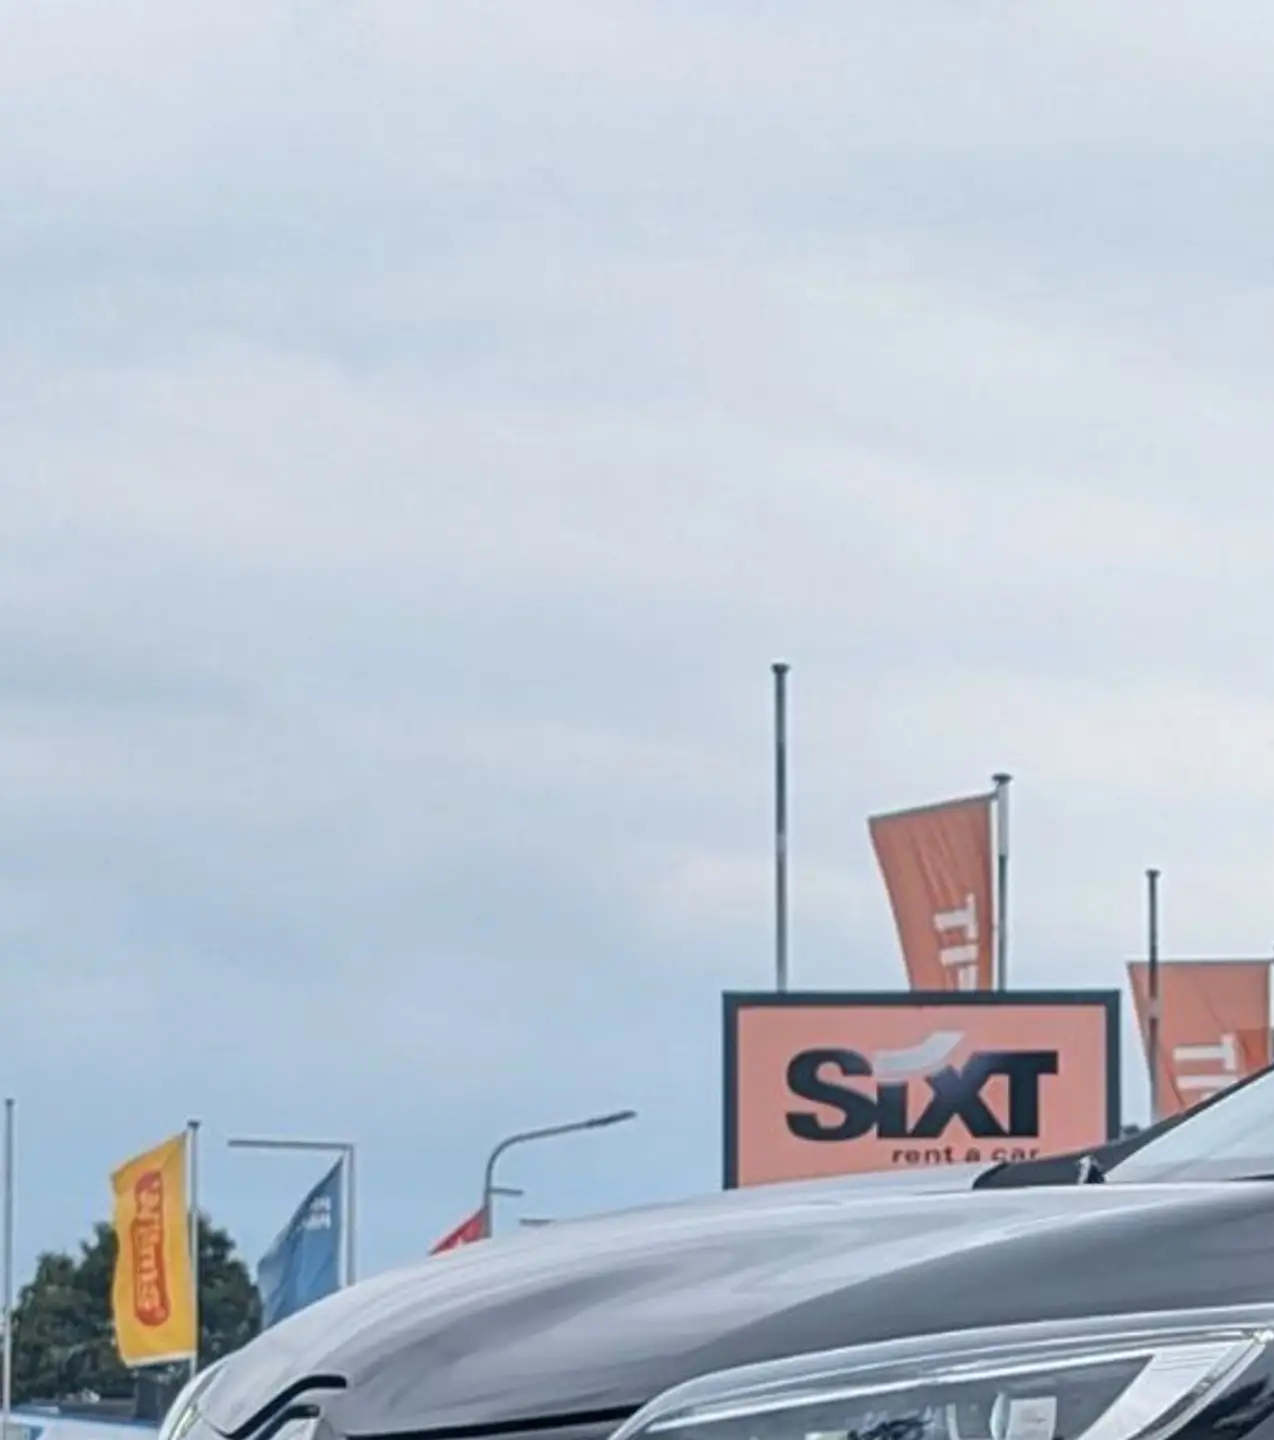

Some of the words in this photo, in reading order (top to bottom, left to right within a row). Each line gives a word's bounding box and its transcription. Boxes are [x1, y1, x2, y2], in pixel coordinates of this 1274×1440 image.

[891, 1146, 953, 1164] rent
[964, 1148, 981, 1163] a
[991, 1148, 1041, 1163] car
